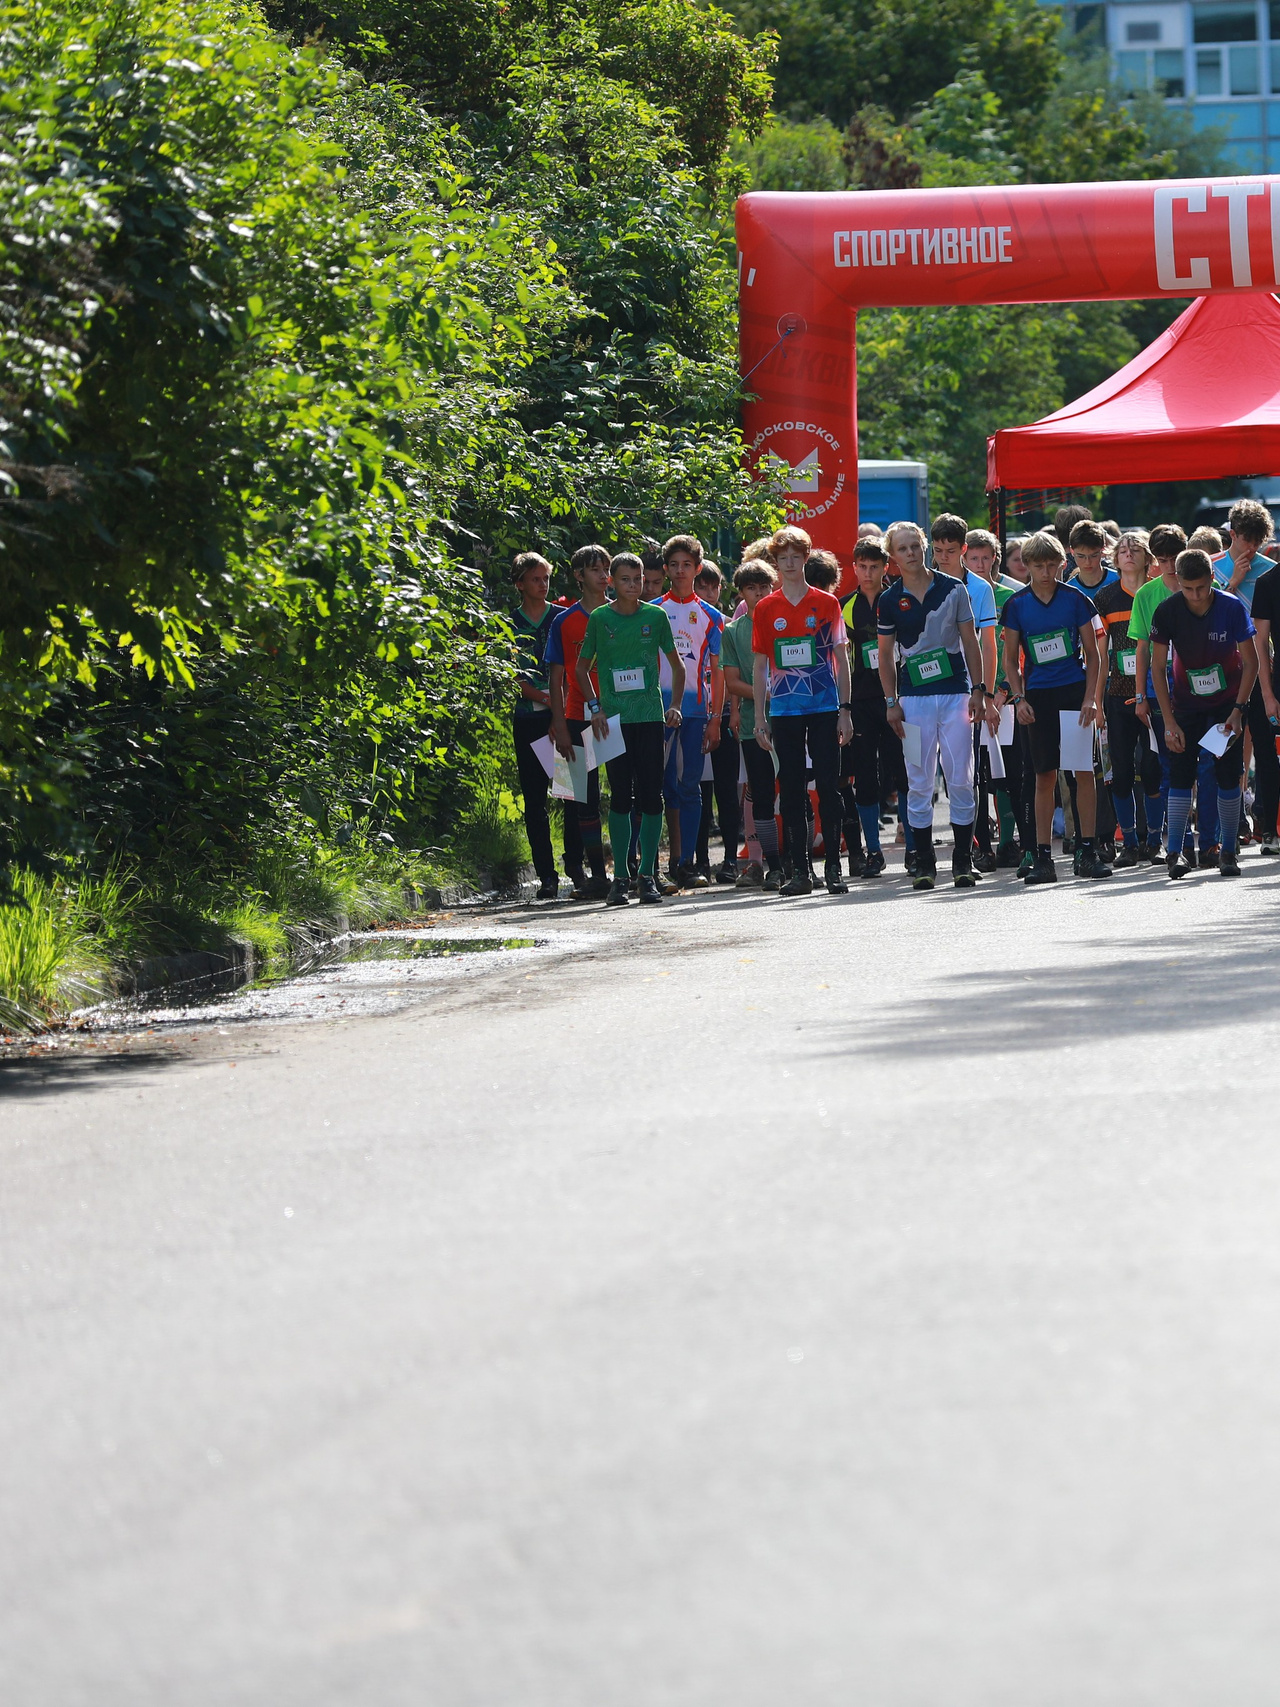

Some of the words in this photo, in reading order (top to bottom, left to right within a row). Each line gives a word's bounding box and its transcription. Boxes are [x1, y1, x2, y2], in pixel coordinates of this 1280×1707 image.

[833, 226, 1013, 268] СПОРТИВНОЕ
[752, 421, 840, 451] МОСКОВСКОЕ
[784, 473, 845, 522] ИРОВАНИЕ
[786, 648, 804, 656] 109.1
[1039, 643, 1059, 654] 107.1
[920, 663, 939, 674] 108.1
[1127, 660, 1136, 668] 12
[619, 674, 637, 682] 110.1
[1198, 677, 1216, 687] 106.1
